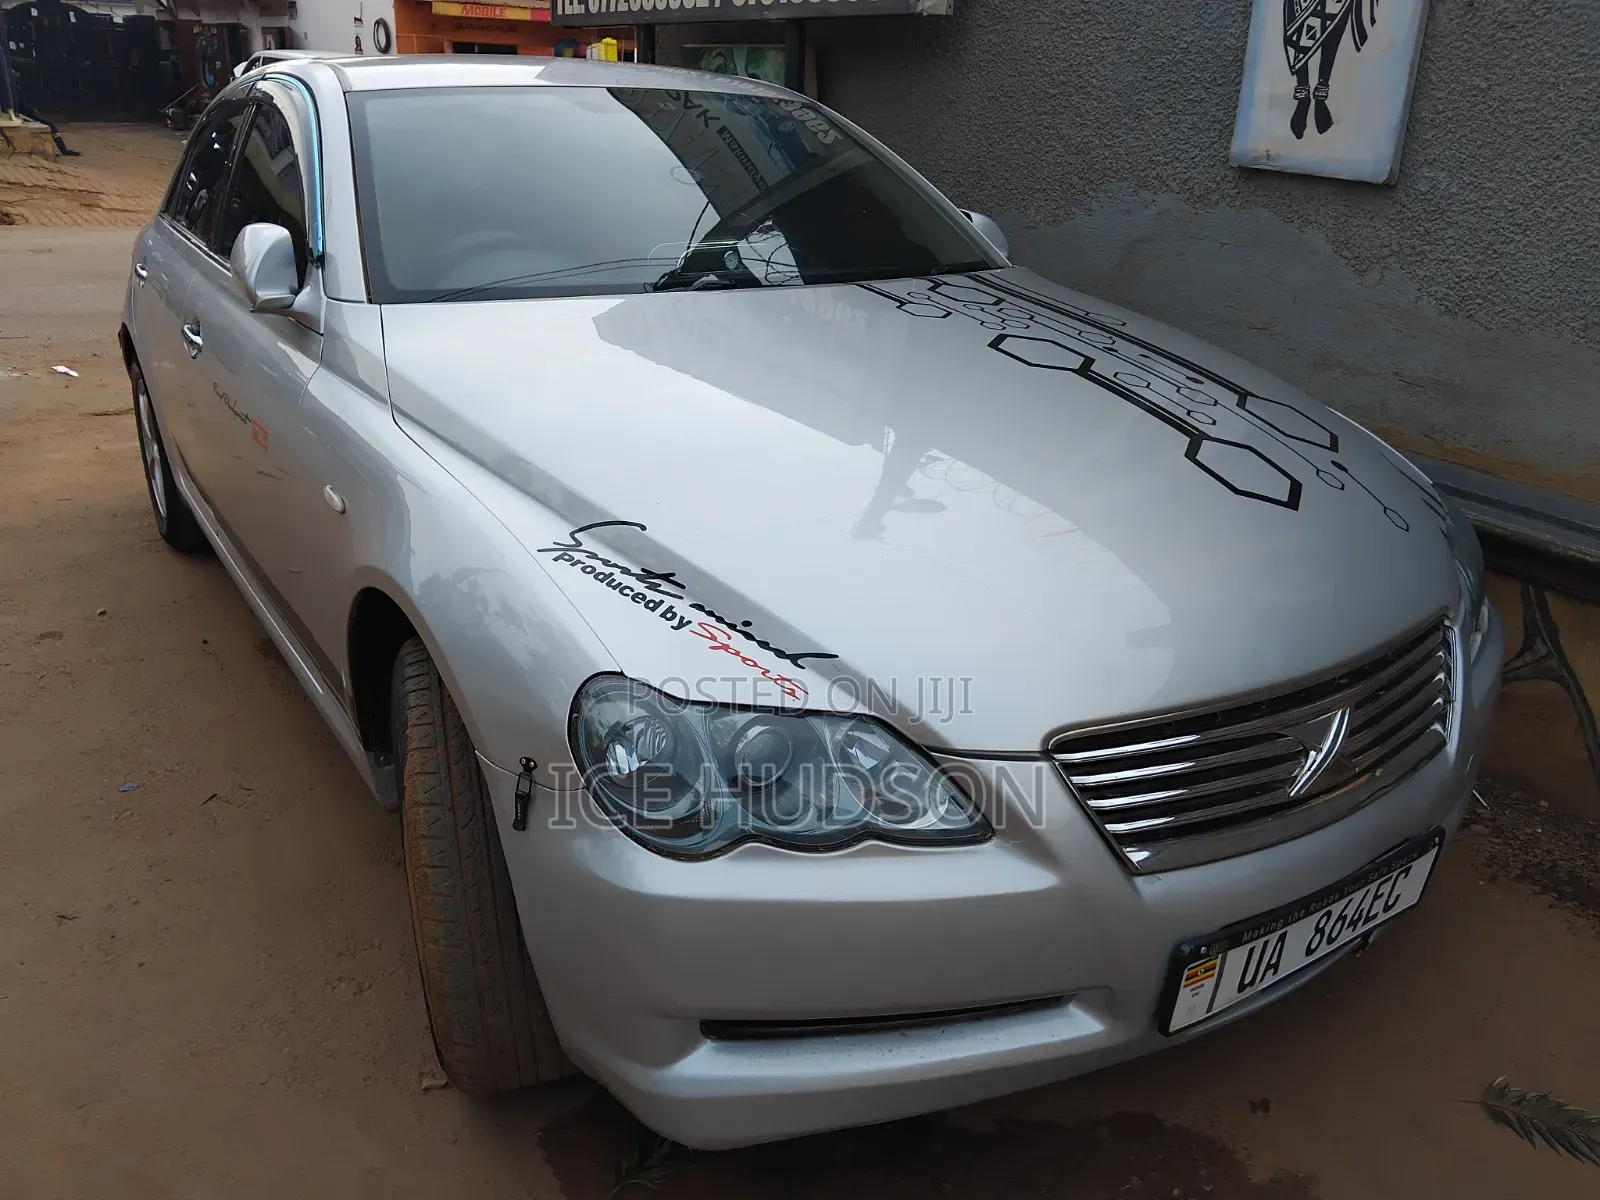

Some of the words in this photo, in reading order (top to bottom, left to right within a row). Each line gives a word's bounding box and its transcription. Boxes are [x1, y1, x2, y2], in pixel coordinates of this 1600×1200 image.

[460, 4, 507, 18] MOBILE
[552, 551, 665, 614] produced
[659, 600, 693, 631] by
[1237, 930, 1288, 994] UA
[1304, 864, 1413, 958] 864EC
[1242, 919, 1285, 943] Making
[1288, 909, 1305, 923] the
[1308, 893, 1339, 914] Roads
[1344, 879, 1365, 895] Your
[1368, 866, 1388, 883] Safe
[1391, 852, 1418, 871] Space
